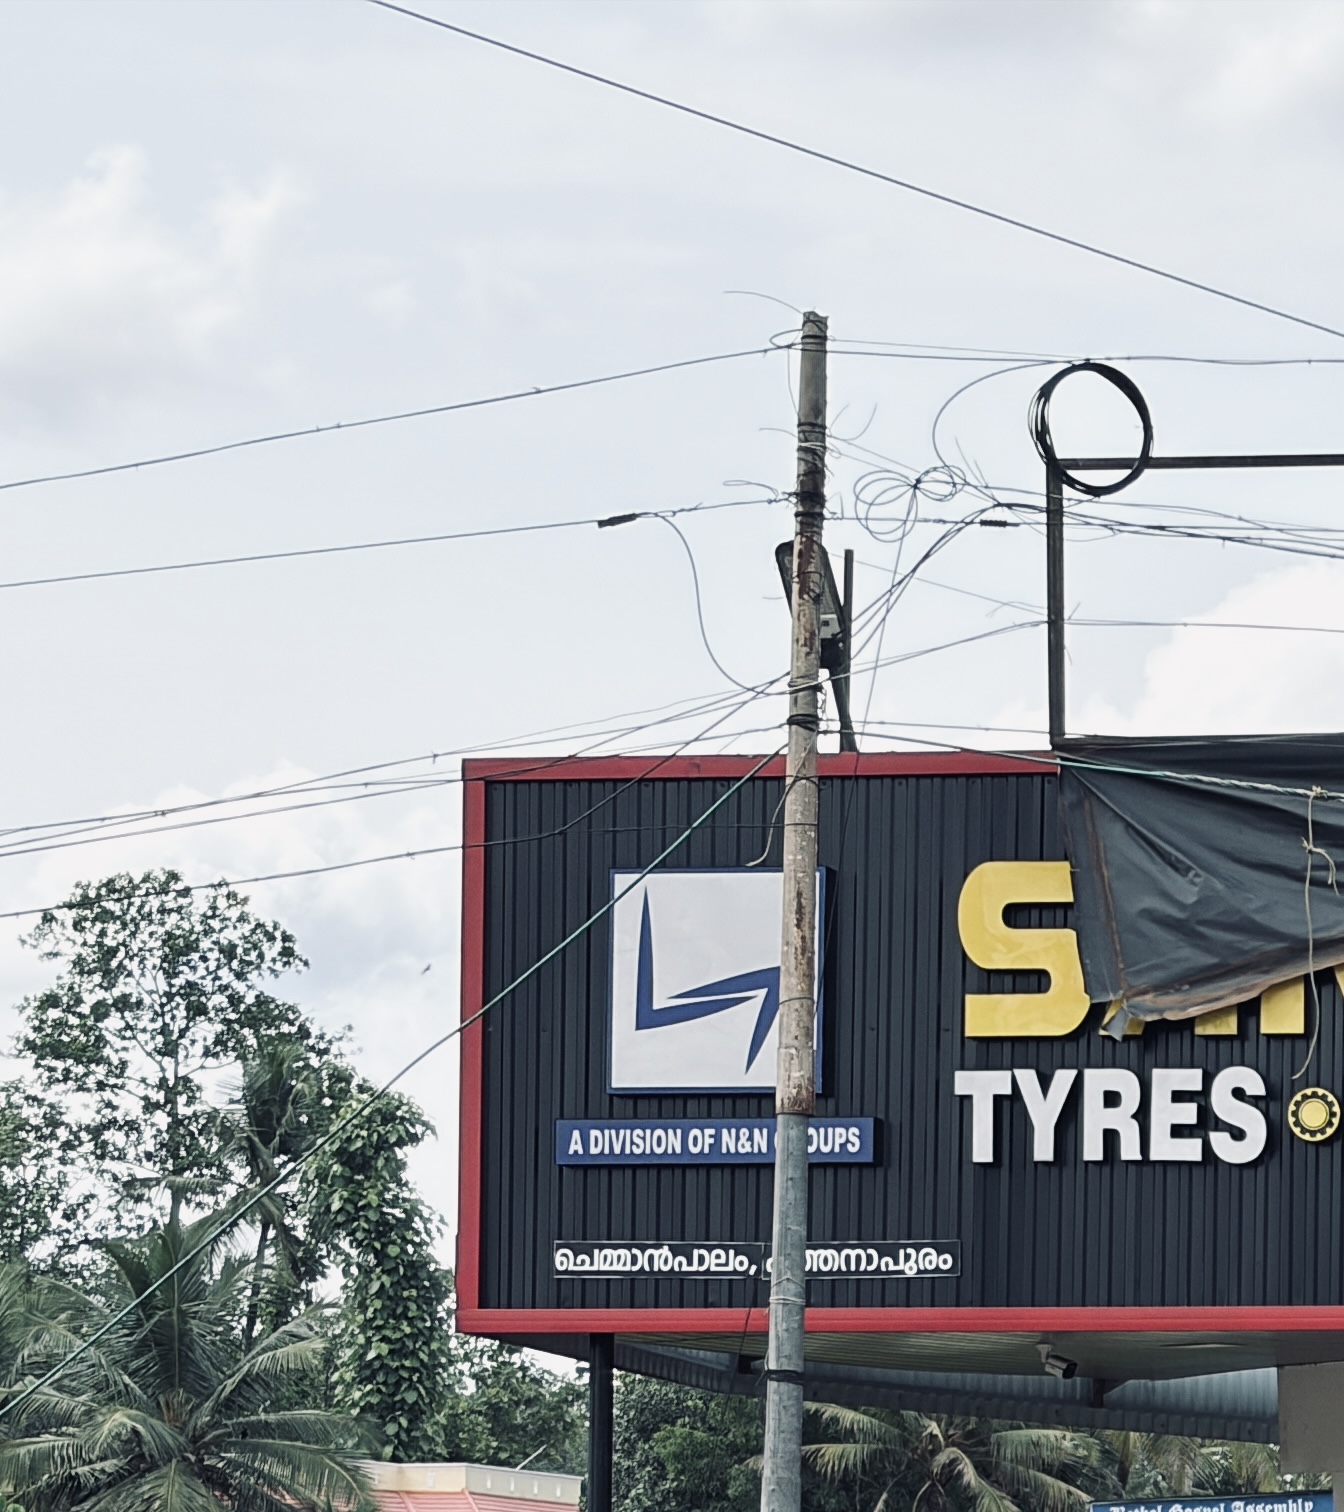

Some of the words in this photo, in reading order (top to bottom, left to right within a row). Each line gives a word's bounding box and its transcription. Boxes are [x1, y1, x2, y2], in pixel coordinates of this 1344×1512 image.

[954, 1066, 1268, 1164] TYRES
[568, 1129, 584, 1155] A
[590, 1128, 682, 1155] DIVISION
[688, 1128, 715, 1154] OF
[721, 1127, 768, 1154] N&N
[773, 1126, 861, 1154] OUPS
[766, 1248, 953, 1276] ത്തനാപുരം
